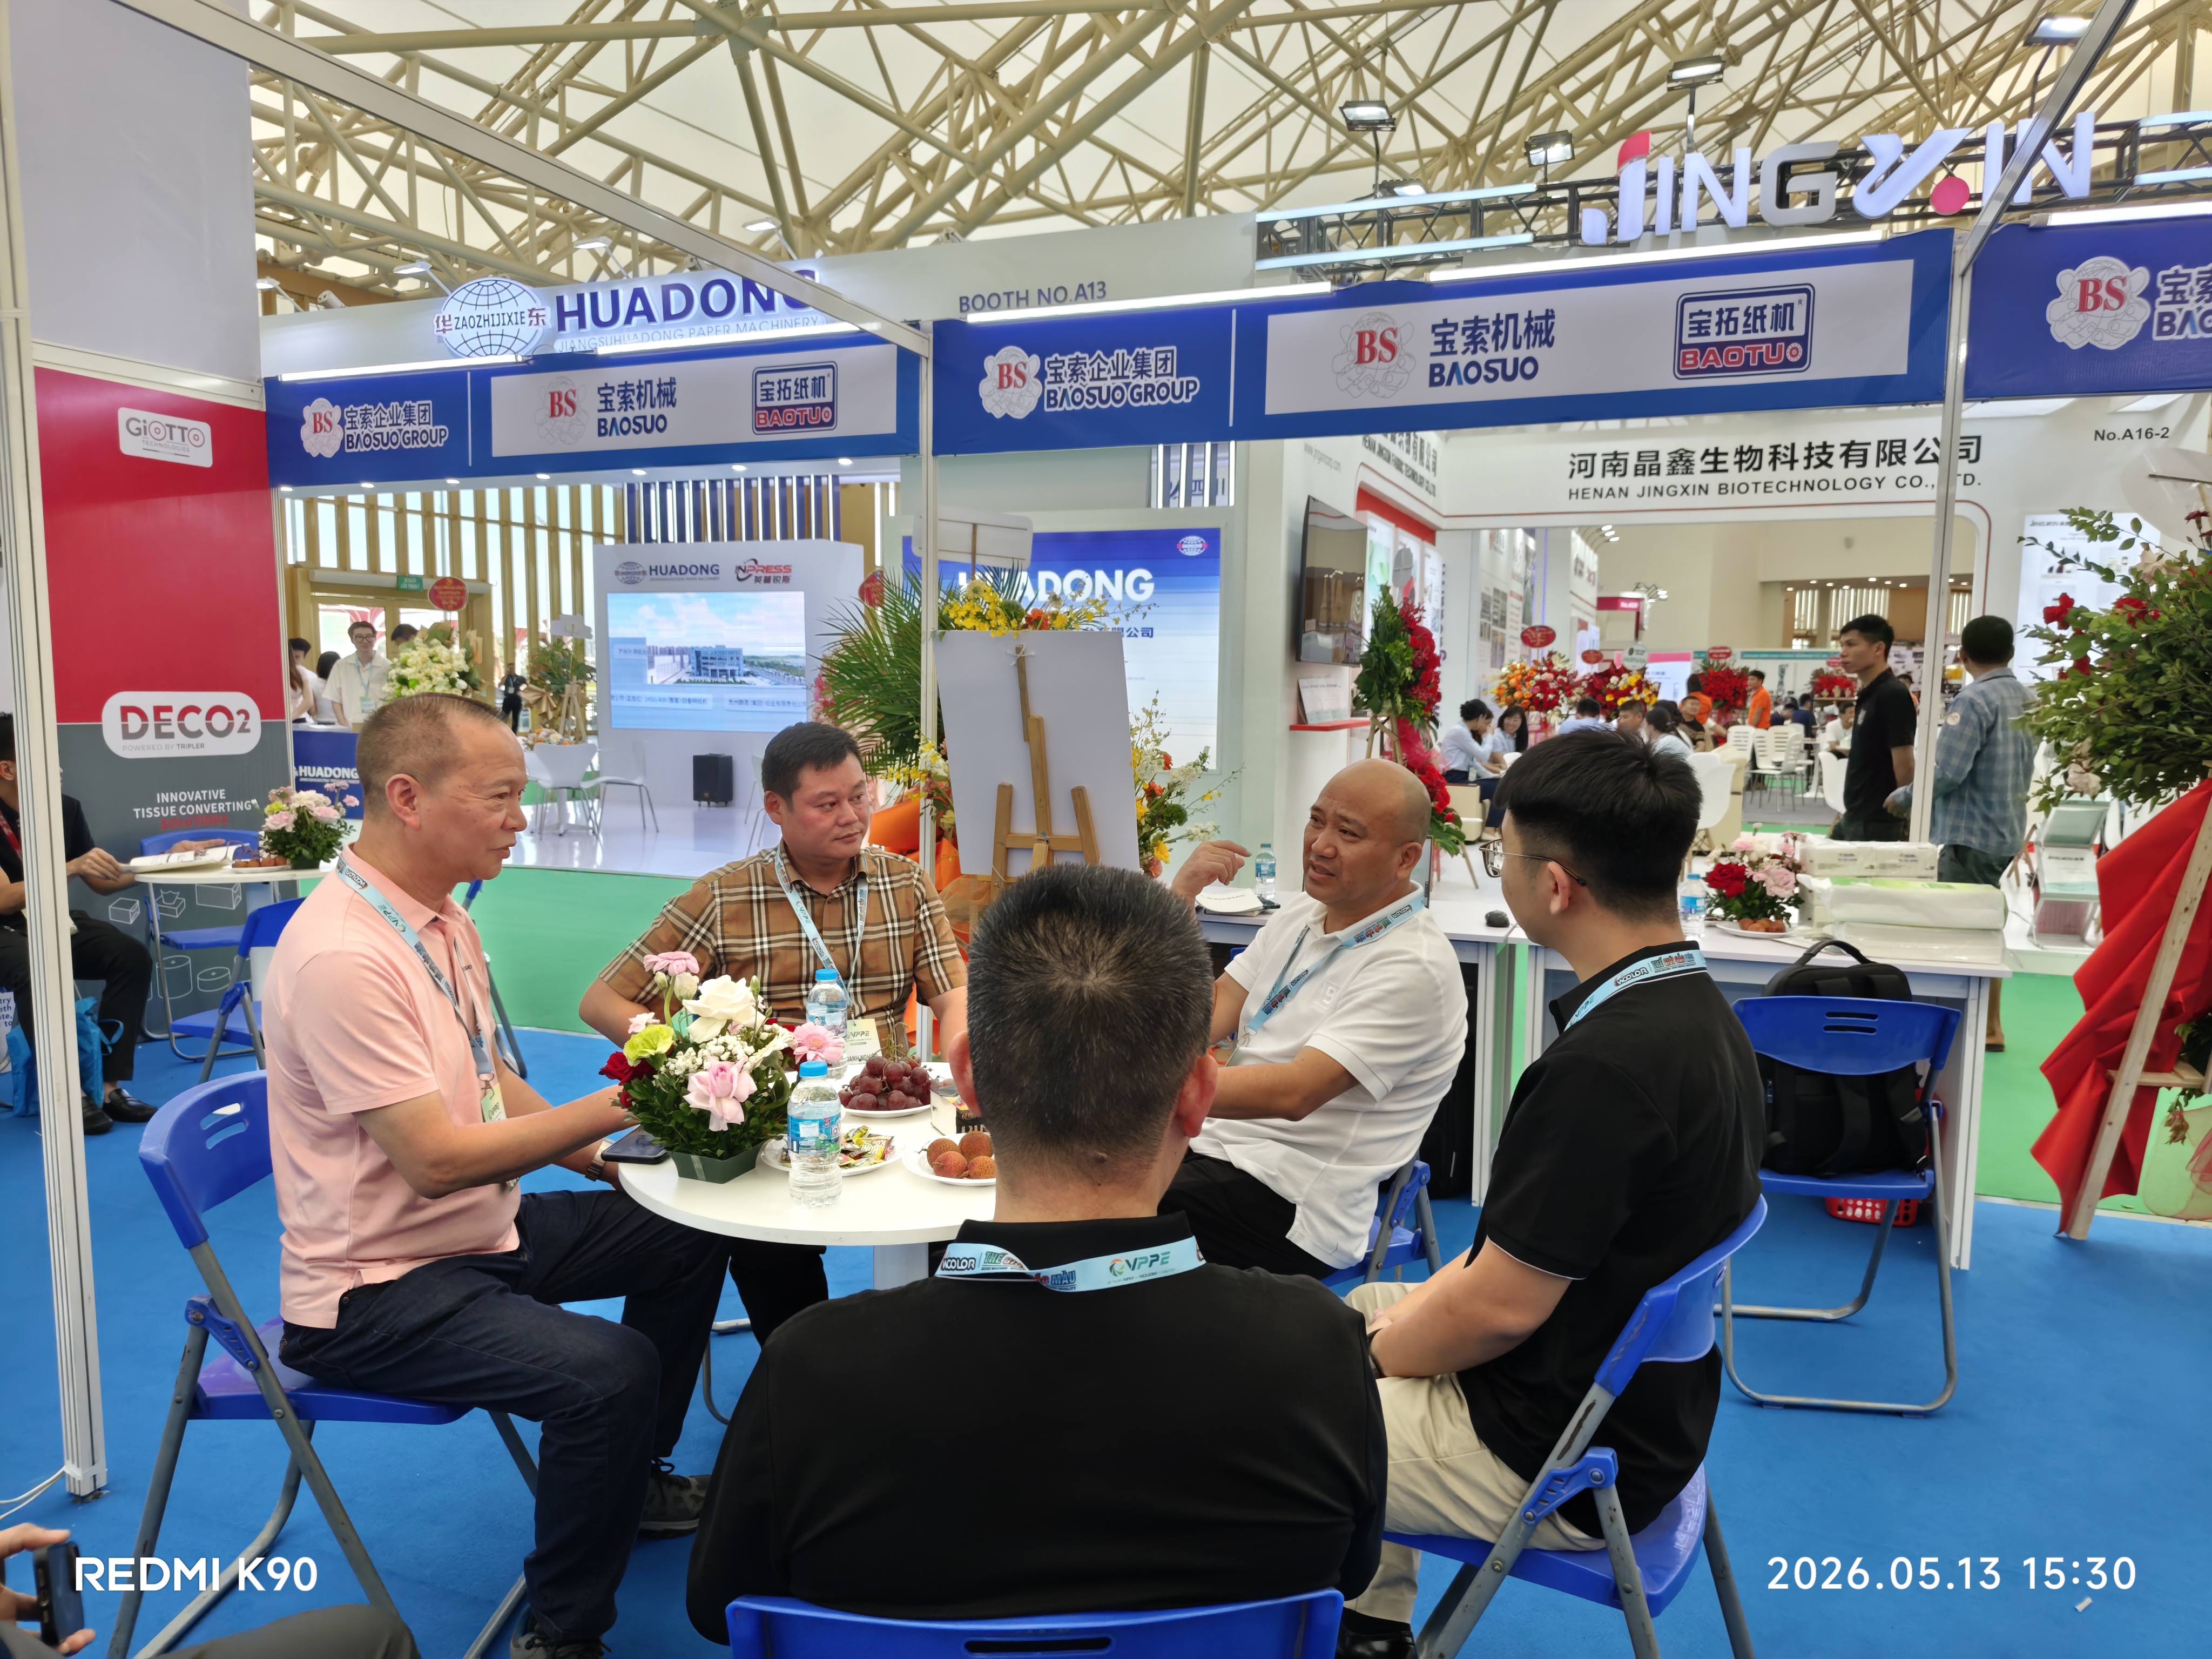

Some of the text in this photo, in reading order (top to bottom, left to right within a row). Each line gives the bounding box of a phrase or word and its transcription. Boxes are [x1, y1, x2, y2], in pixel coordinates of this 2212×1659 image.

[959, 281, 1107, 313] BOOTH NO.A13
[2075, 275, 2127, 313] BS
[435, 314, 452, 334] 华
[454, 311, 525, 331] ZAOZHIJIXIE
[528, 308, 546, 326] 东
[1687, 299, 1796, 339] 宝拓纸机
[1429, 308, 1556, 357] 宝索机械
[1354, 327, 1398, 365] BS
[997, 361, 1027, 390] BS
[1045, 348, 1176, 385] 宝索企业集团
[1428, 356, 1539, 388] BAOSUO
[597, 377, 677, 413] 宝索机械
[760, 376, 827, 402] 宝拓纸机
[1046, 380, 1198, 409] BAOSUO GROUP
[345, 401, 432, 428] 宝索企业集团
[549, 389, 577, 419] BS
[312, 412, 333, 434] BS
[597, 414, 667, 437] BAOSUO
[2094, 427, 2170, 442] No.A16-2
[141, 439, 191, 453] TECHNOLOGIES
[402, 428, 448, 448] GROUP
[1568, 435, 1982, 480] 河南晶鑫生物科技有限公司
[1568, 485, 1629, 501] HENAN
[1637, 483, 1709, 498] JINGXIN
[1718, 476, 1886, 496] BIOTECHNOLOGY
[649, 564, 720, 576] HUADONG
[122, 744, 163, 752] POWERED
[298, 765, 360, 779] HUADONG
[156, 789, 226, 803] INNOVATIVE
[133, 800, 252, 819] TISSUE CONVERTING
[160, 814, 228, 830] SOLUTIONS
[1125, 1251, 1171, 1271] VPPE
